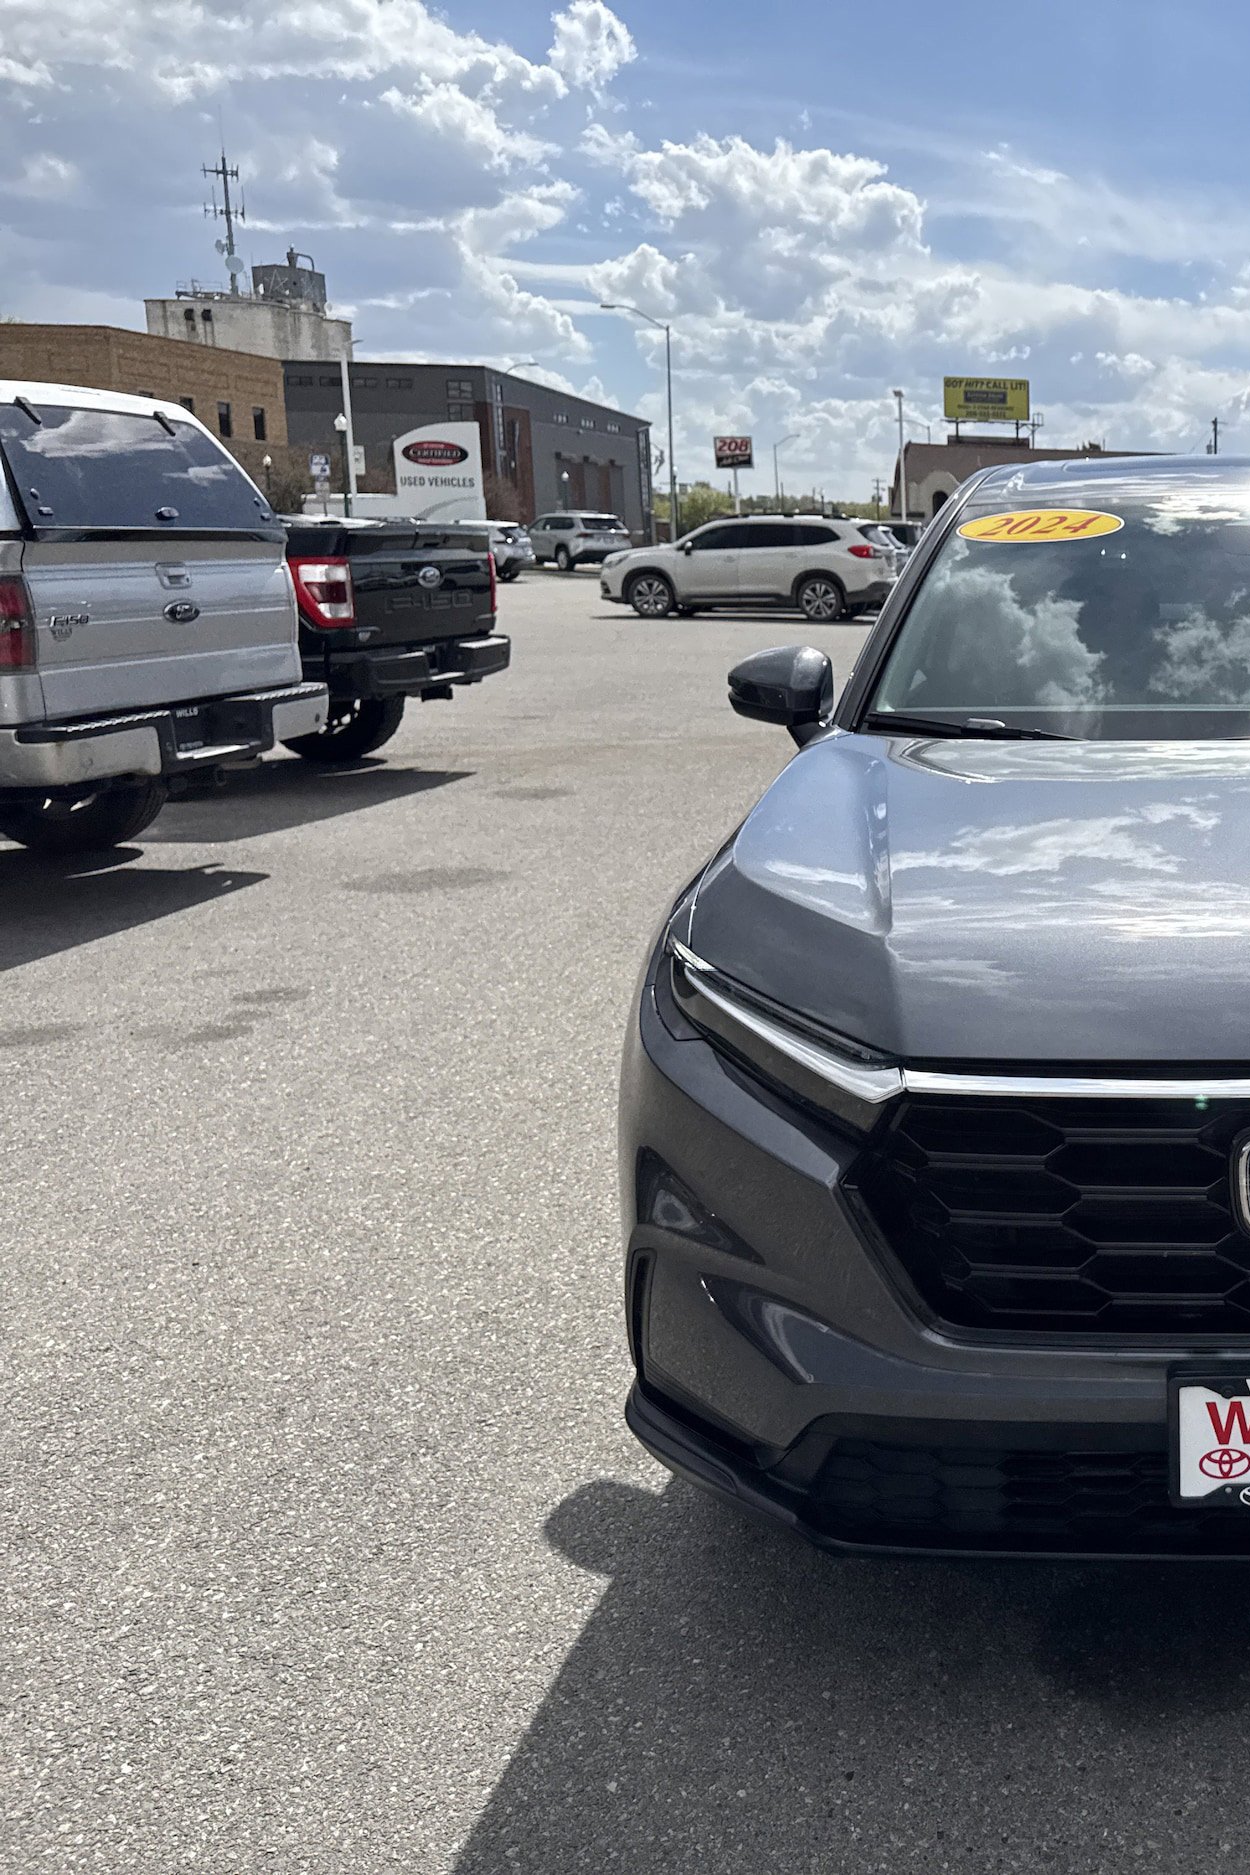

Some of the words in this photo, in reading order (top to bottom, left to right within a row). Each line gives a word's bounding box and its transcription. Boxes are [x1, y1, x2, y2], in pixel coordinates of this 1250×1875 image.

[986, 382, 1008, 390] CALL
[400, 476, 425, 487] USED
[428, 477, 475, 488] VEHICLES
[976, 515, 1100, 537] 2024
[176, 706, 199, 718] WILLS
